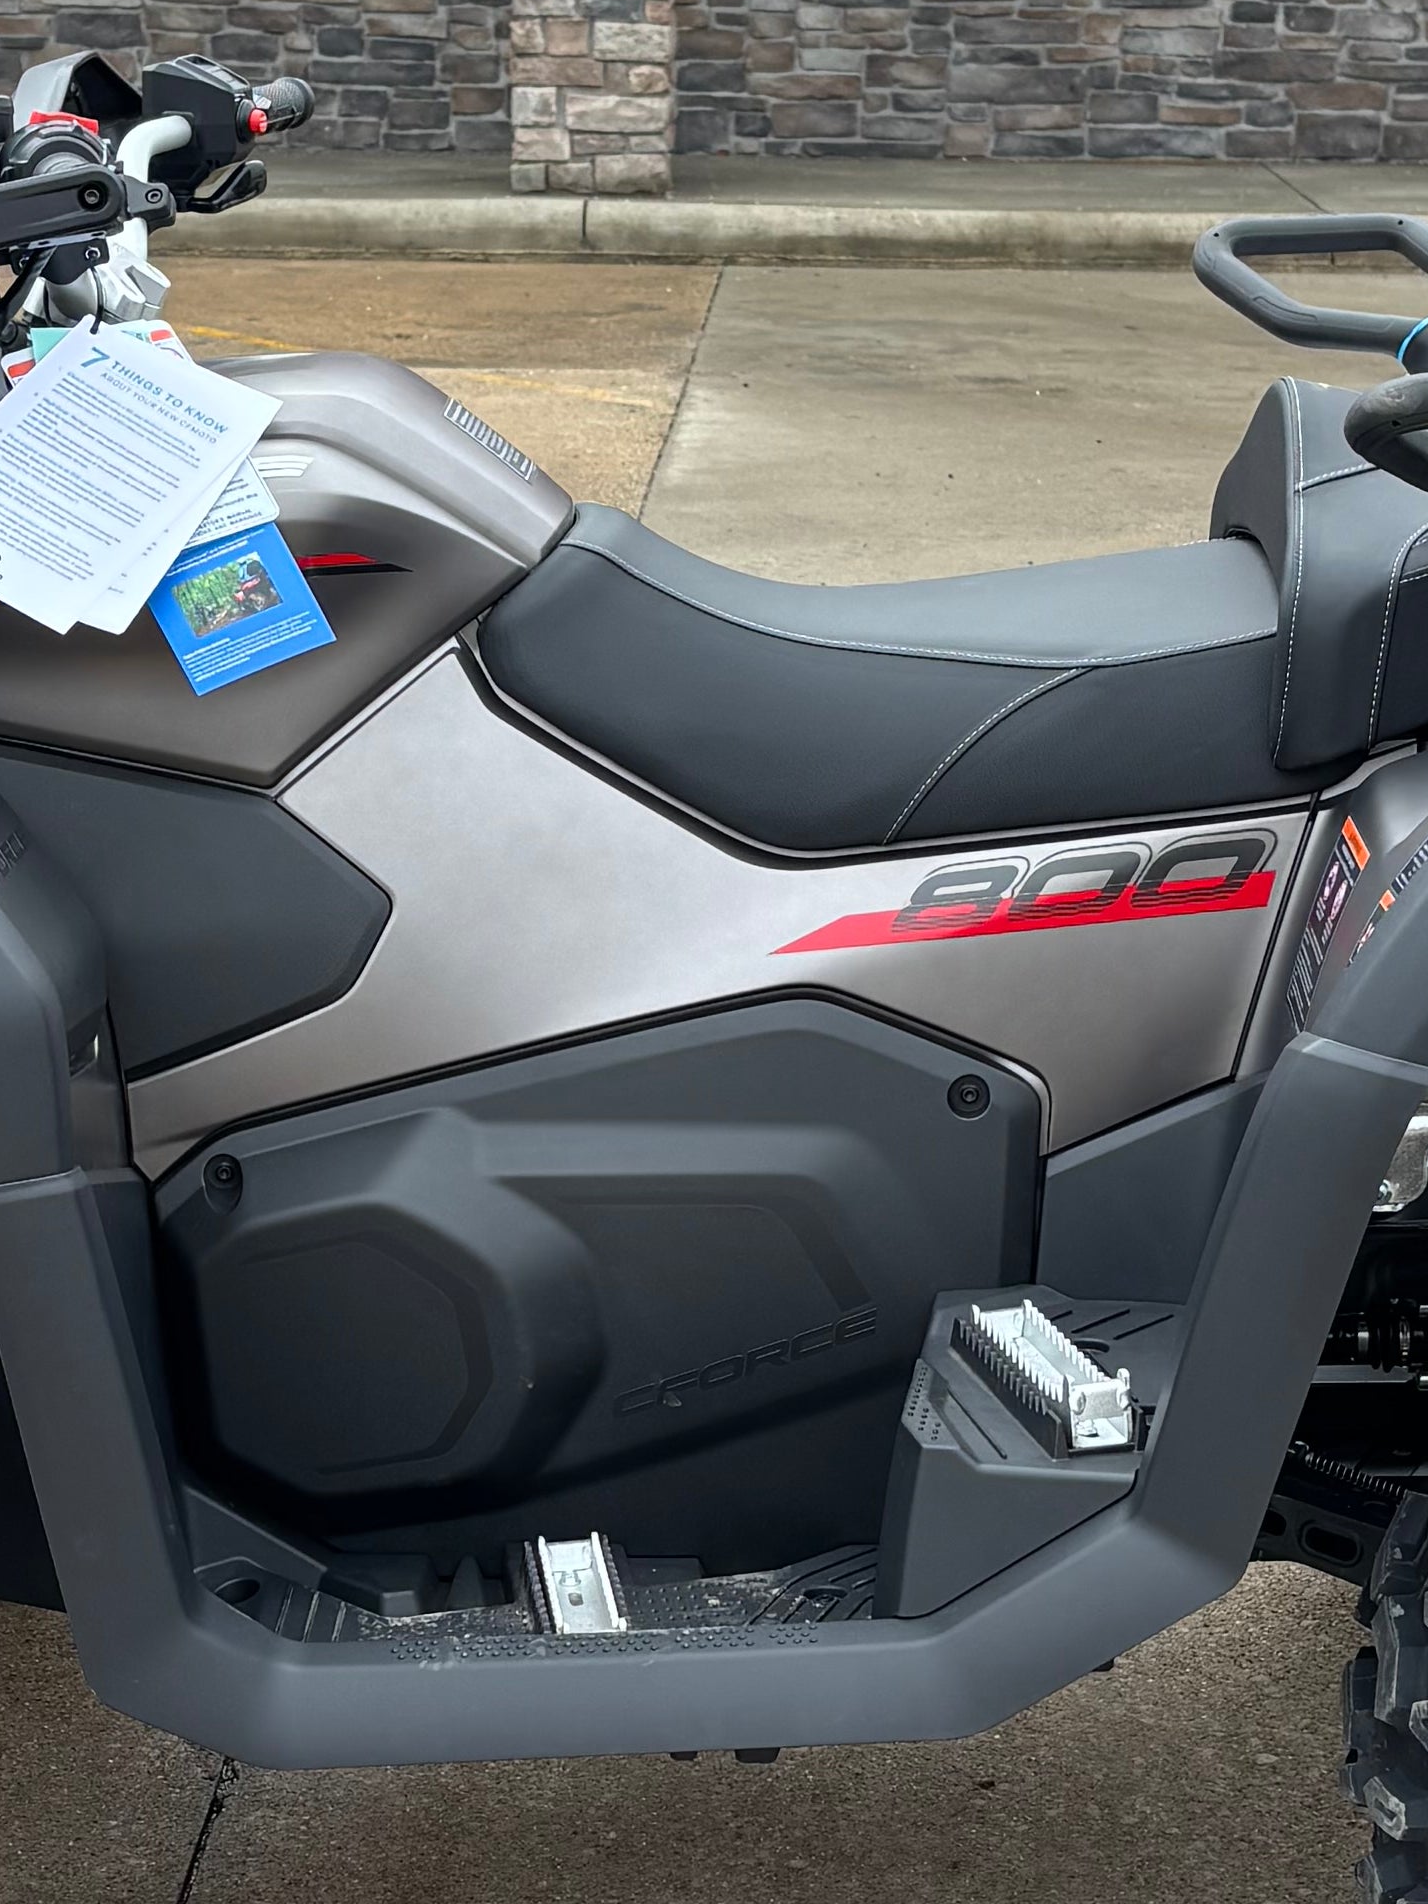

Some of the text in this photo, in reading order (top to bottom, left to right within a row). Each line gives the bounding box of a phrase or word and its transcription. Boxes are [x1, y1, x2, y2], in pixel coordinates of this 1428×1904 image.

[80, 346, 229, 434] 7 THINGS TO KNOW
[100, 372, 131, 394] ABOUT
[132, 390, 158, 410] YOUR
[157, 405, 179, 424] NEW
[891, 829, 1278, 933] 800
[614, 1308, 877, 1418] CFORCE
